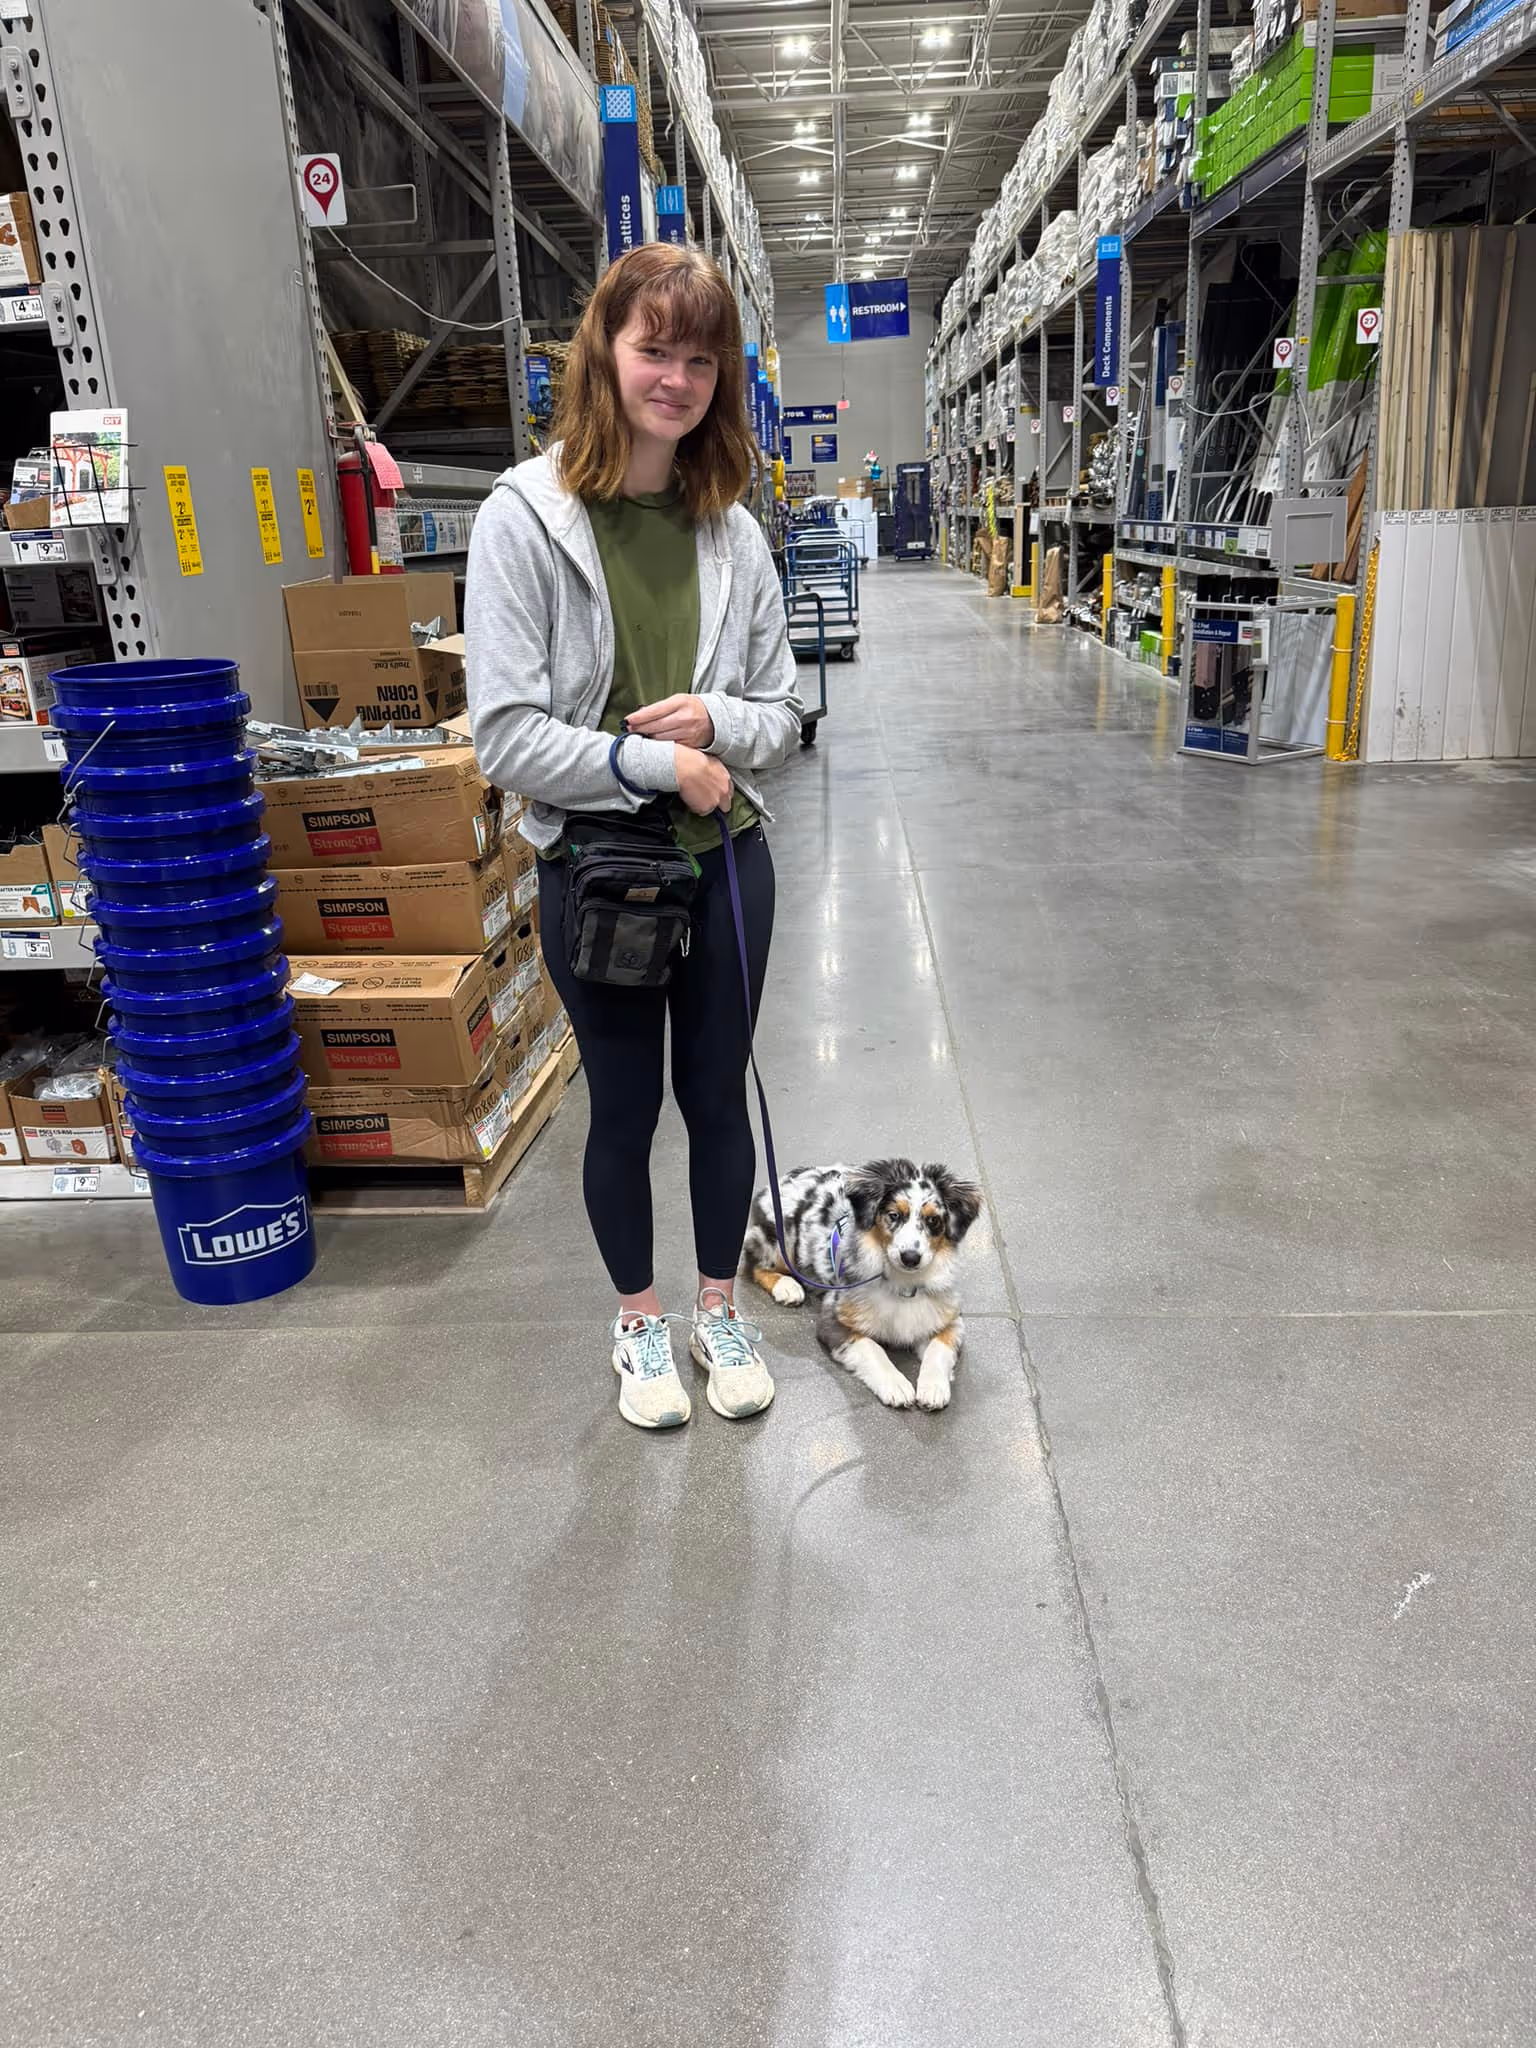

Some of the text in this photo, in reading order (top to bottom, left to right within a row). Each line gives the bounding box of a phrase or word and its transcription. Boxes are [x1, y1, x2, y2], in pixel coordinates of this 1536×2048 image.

[312, 172, 331, 186] 24
[620, 194, 633, 253] Lattices
[852, 303, 899, 316] RESTROOM
[1364, 317, 1374, 325] 27
[1101, 295, 1113, 378] Deck Components
[104, 417, 121, 426] DIY
[376, 684, 418, 701] CORN
[356, 704, 422, 722] POPPING
[308, 811, 371, 828] SIMPSON
[313, 833, 377, 850] Strong-Tie
[323, 901, 385, 914] SIMPSON
[328, 921, 389, 936] Strong-Tie
[327, 1032, 391, 1044] SIMPSON
[331, 1052, 396, 1065] Strong-Tie
[321, 1116, 386, 1131] SIMPSON
[191, 1210, 301, 1259] LOWE'S
